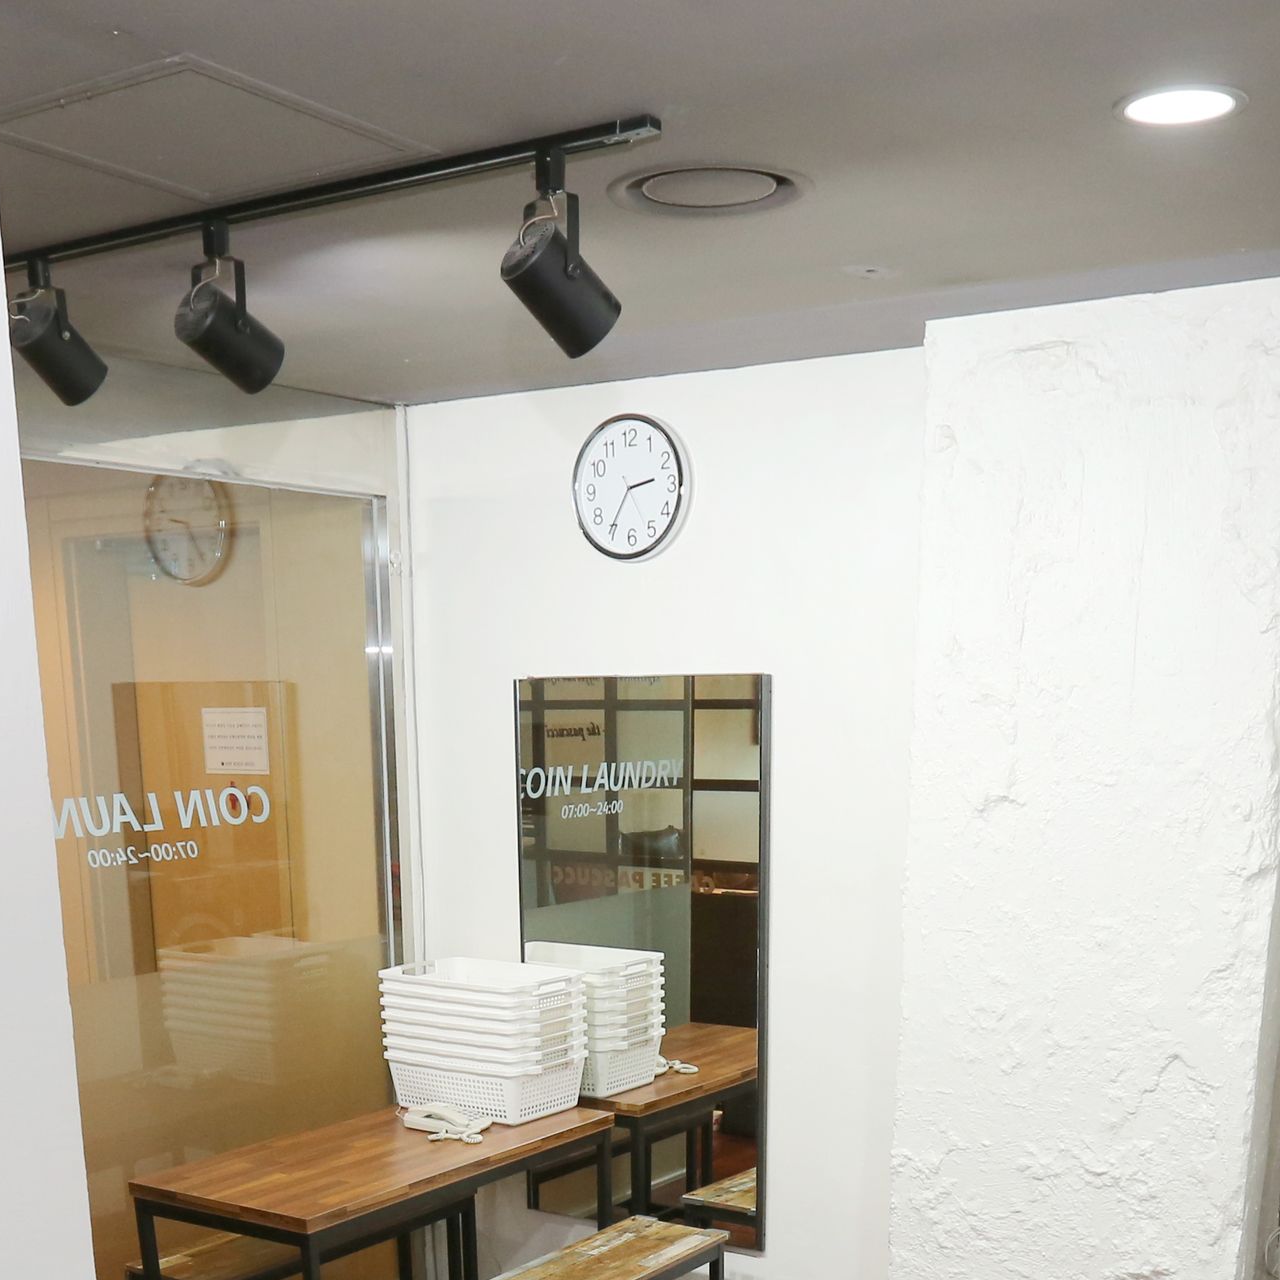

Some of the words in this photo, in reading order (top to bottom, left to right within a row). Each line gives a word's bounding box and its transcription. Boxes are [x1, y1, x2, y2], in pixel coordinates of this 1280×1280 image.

[622, 428, 638, 447] 12
[647, 434, 652, 452] 1
[603, 440, 615, 458] 11
[591, 459, 606, 478] 10
[661, 451, 670, 470] 2
[667, 474, 677, 493] 3
[586, 484, 596, 502] 9
[593, 507, 604, 526] 8
[660, 500, 671, 518] 4
[609, 523, 618, 541] 7
[627, 528, 637, 546] 6
[646, 520, 656, 538] 5
[580, 759, 684, 795] LAUNDRY
